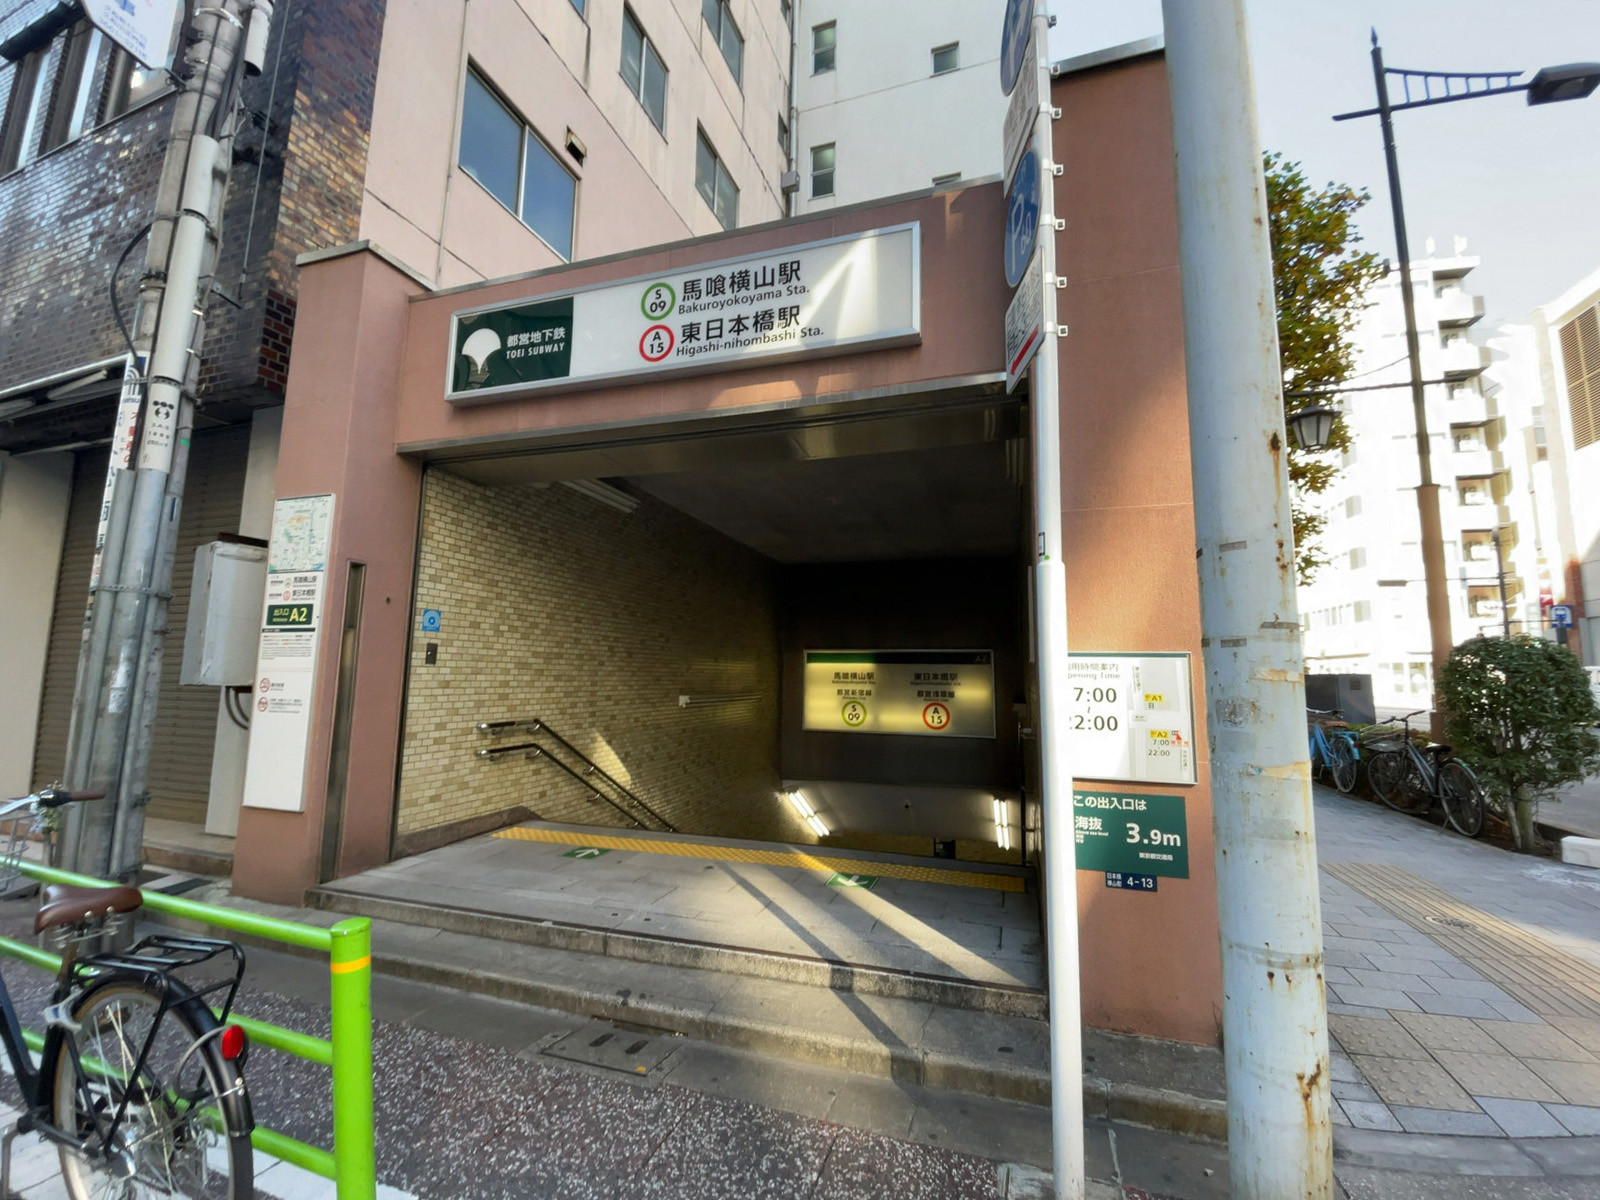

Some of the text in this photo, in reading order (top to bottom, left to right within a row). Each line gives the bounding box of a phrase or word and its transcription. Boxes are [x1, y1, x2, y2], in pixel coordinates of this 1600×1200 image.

[682, 259, 801, 302] 馬喰横山駅
[655, 289, 662, 300] S
[678, 283, 810, 315] Bakuroyokoyama Sta.
[649, 300, 667, 313] 09
[680, 305, 801, 344] 東日本橋駅
[507, 326, 566, 347] 都営地下鉄
[652, 331, 661, 342] A
[676, 326, 824, 357] Higashi-nihombashi Sta.
[506, 342, 565, 359] TOEI SUBWAY
[649, 342, 664, 354] 15
[289, 607, 307, 622] A2
[1073, 687, 1117, 703] 7:00
[848, 713, 860, 722] 09
[930, 716, 943, 725] 15
[1069, 715, 1118, 731] 2:00
[1073, 795, 1147, 810] この出入口は
[1075, 816, 1102, 830] 海抜
[1126, 823, 1181, 847] 3.9m
[1127, 876, 1153, 888] 4-13
